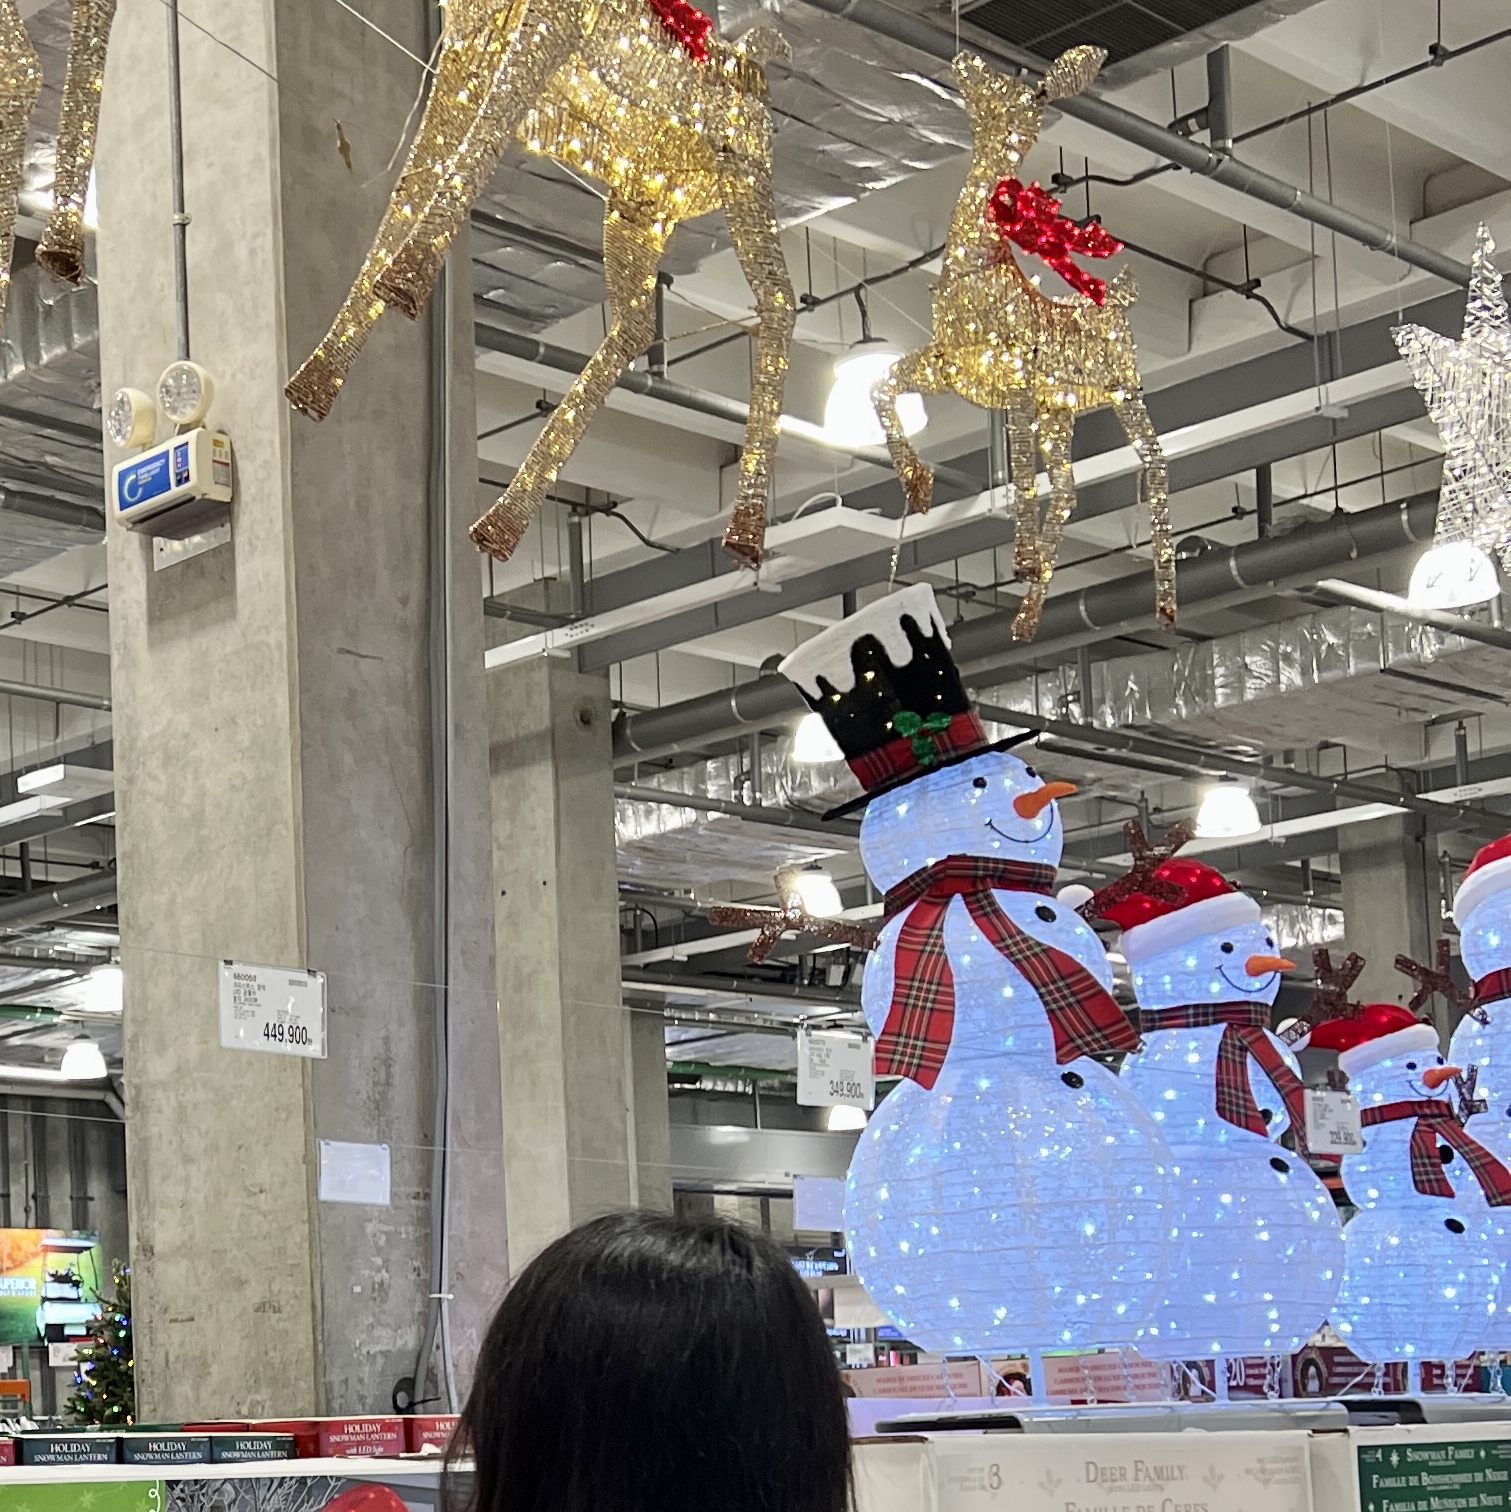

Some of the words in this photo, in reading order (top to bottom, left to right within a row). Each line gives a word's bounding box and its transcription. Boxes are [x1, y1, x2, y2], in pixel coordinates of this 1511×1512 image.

[344, 1423, 381, 1434] HOLIDAY
[50, 1443, 91, 1453] HOLIDAY
[149, 1441, 187, 1452] HOLIDAY
[235, 1440, 273, 1450] HOLIDAY
[989, 1463, 1002, 1490] 3
[1084, 1461, 1127, 1483] DEER
[1133, 1459, 1186, 1482] FAMILY
